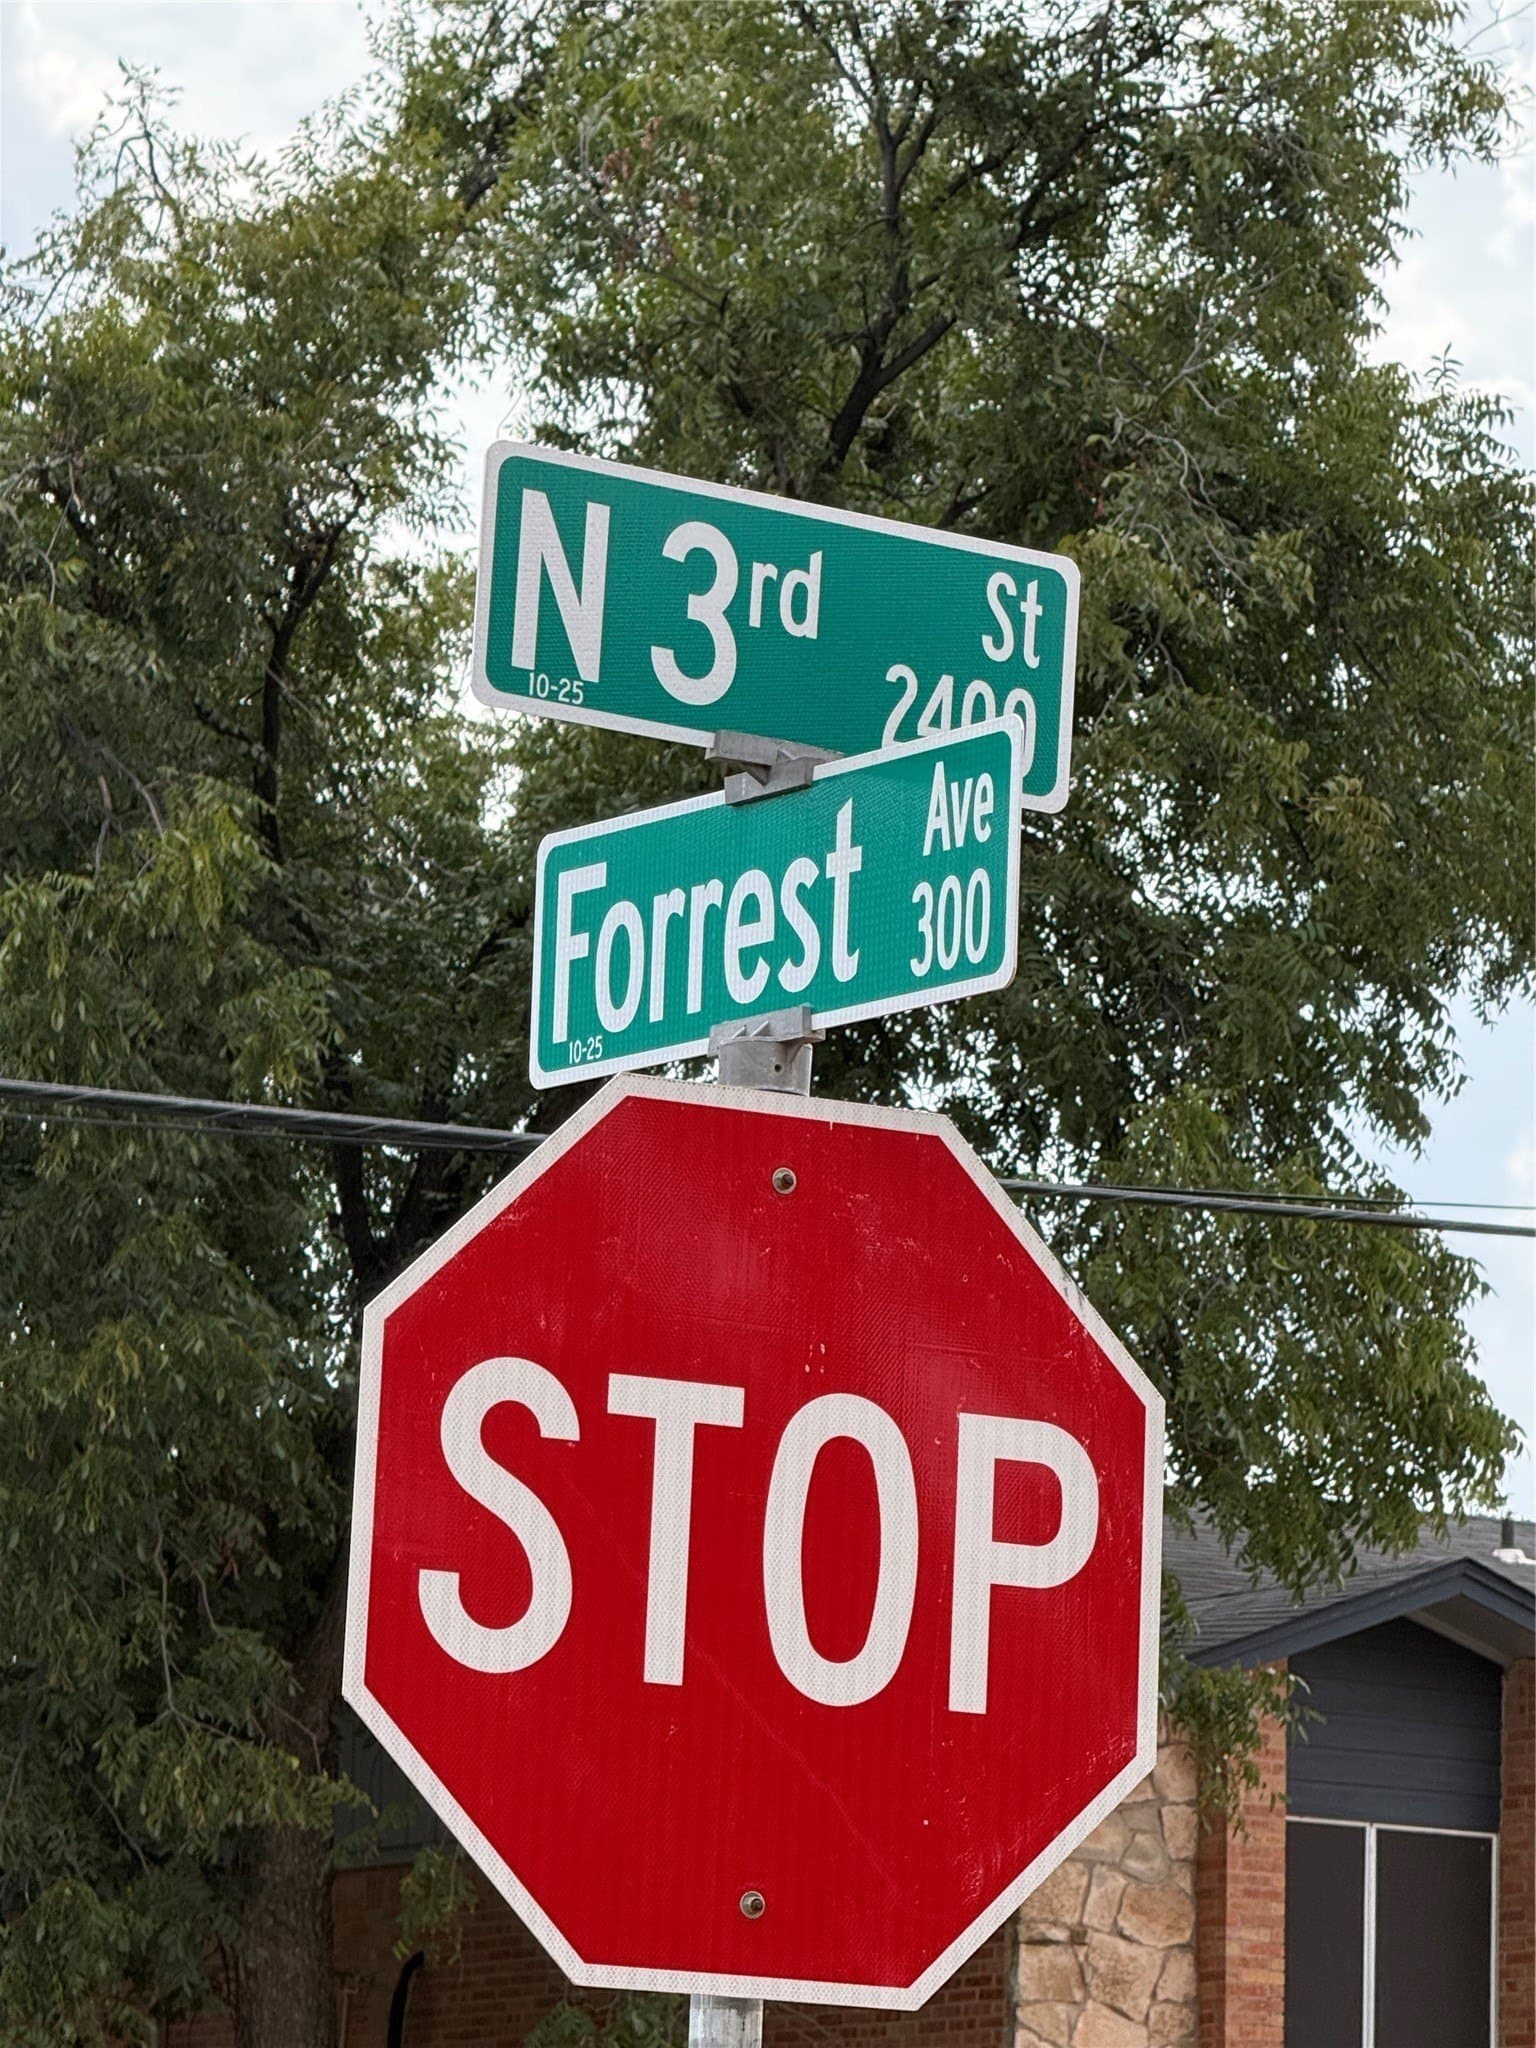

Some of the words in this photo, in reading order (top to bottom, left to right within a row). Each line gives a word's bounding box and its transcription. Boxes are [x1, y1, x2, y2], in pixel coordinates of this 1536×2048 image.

[511, 487, 611, 683] N
[650, 520, 823, 706] 3rd
[981, 571, 1043, 669] St
[529, 671, 584, 705] 10-25
[552, 797, 863, 1044] Forrest
[923, 760, 994, 857] Ave
[910, 867, 991, 977] 300
[568, 1035, 604, 1065] 10-25
[418, 1356, 1100, 1715] STOP
